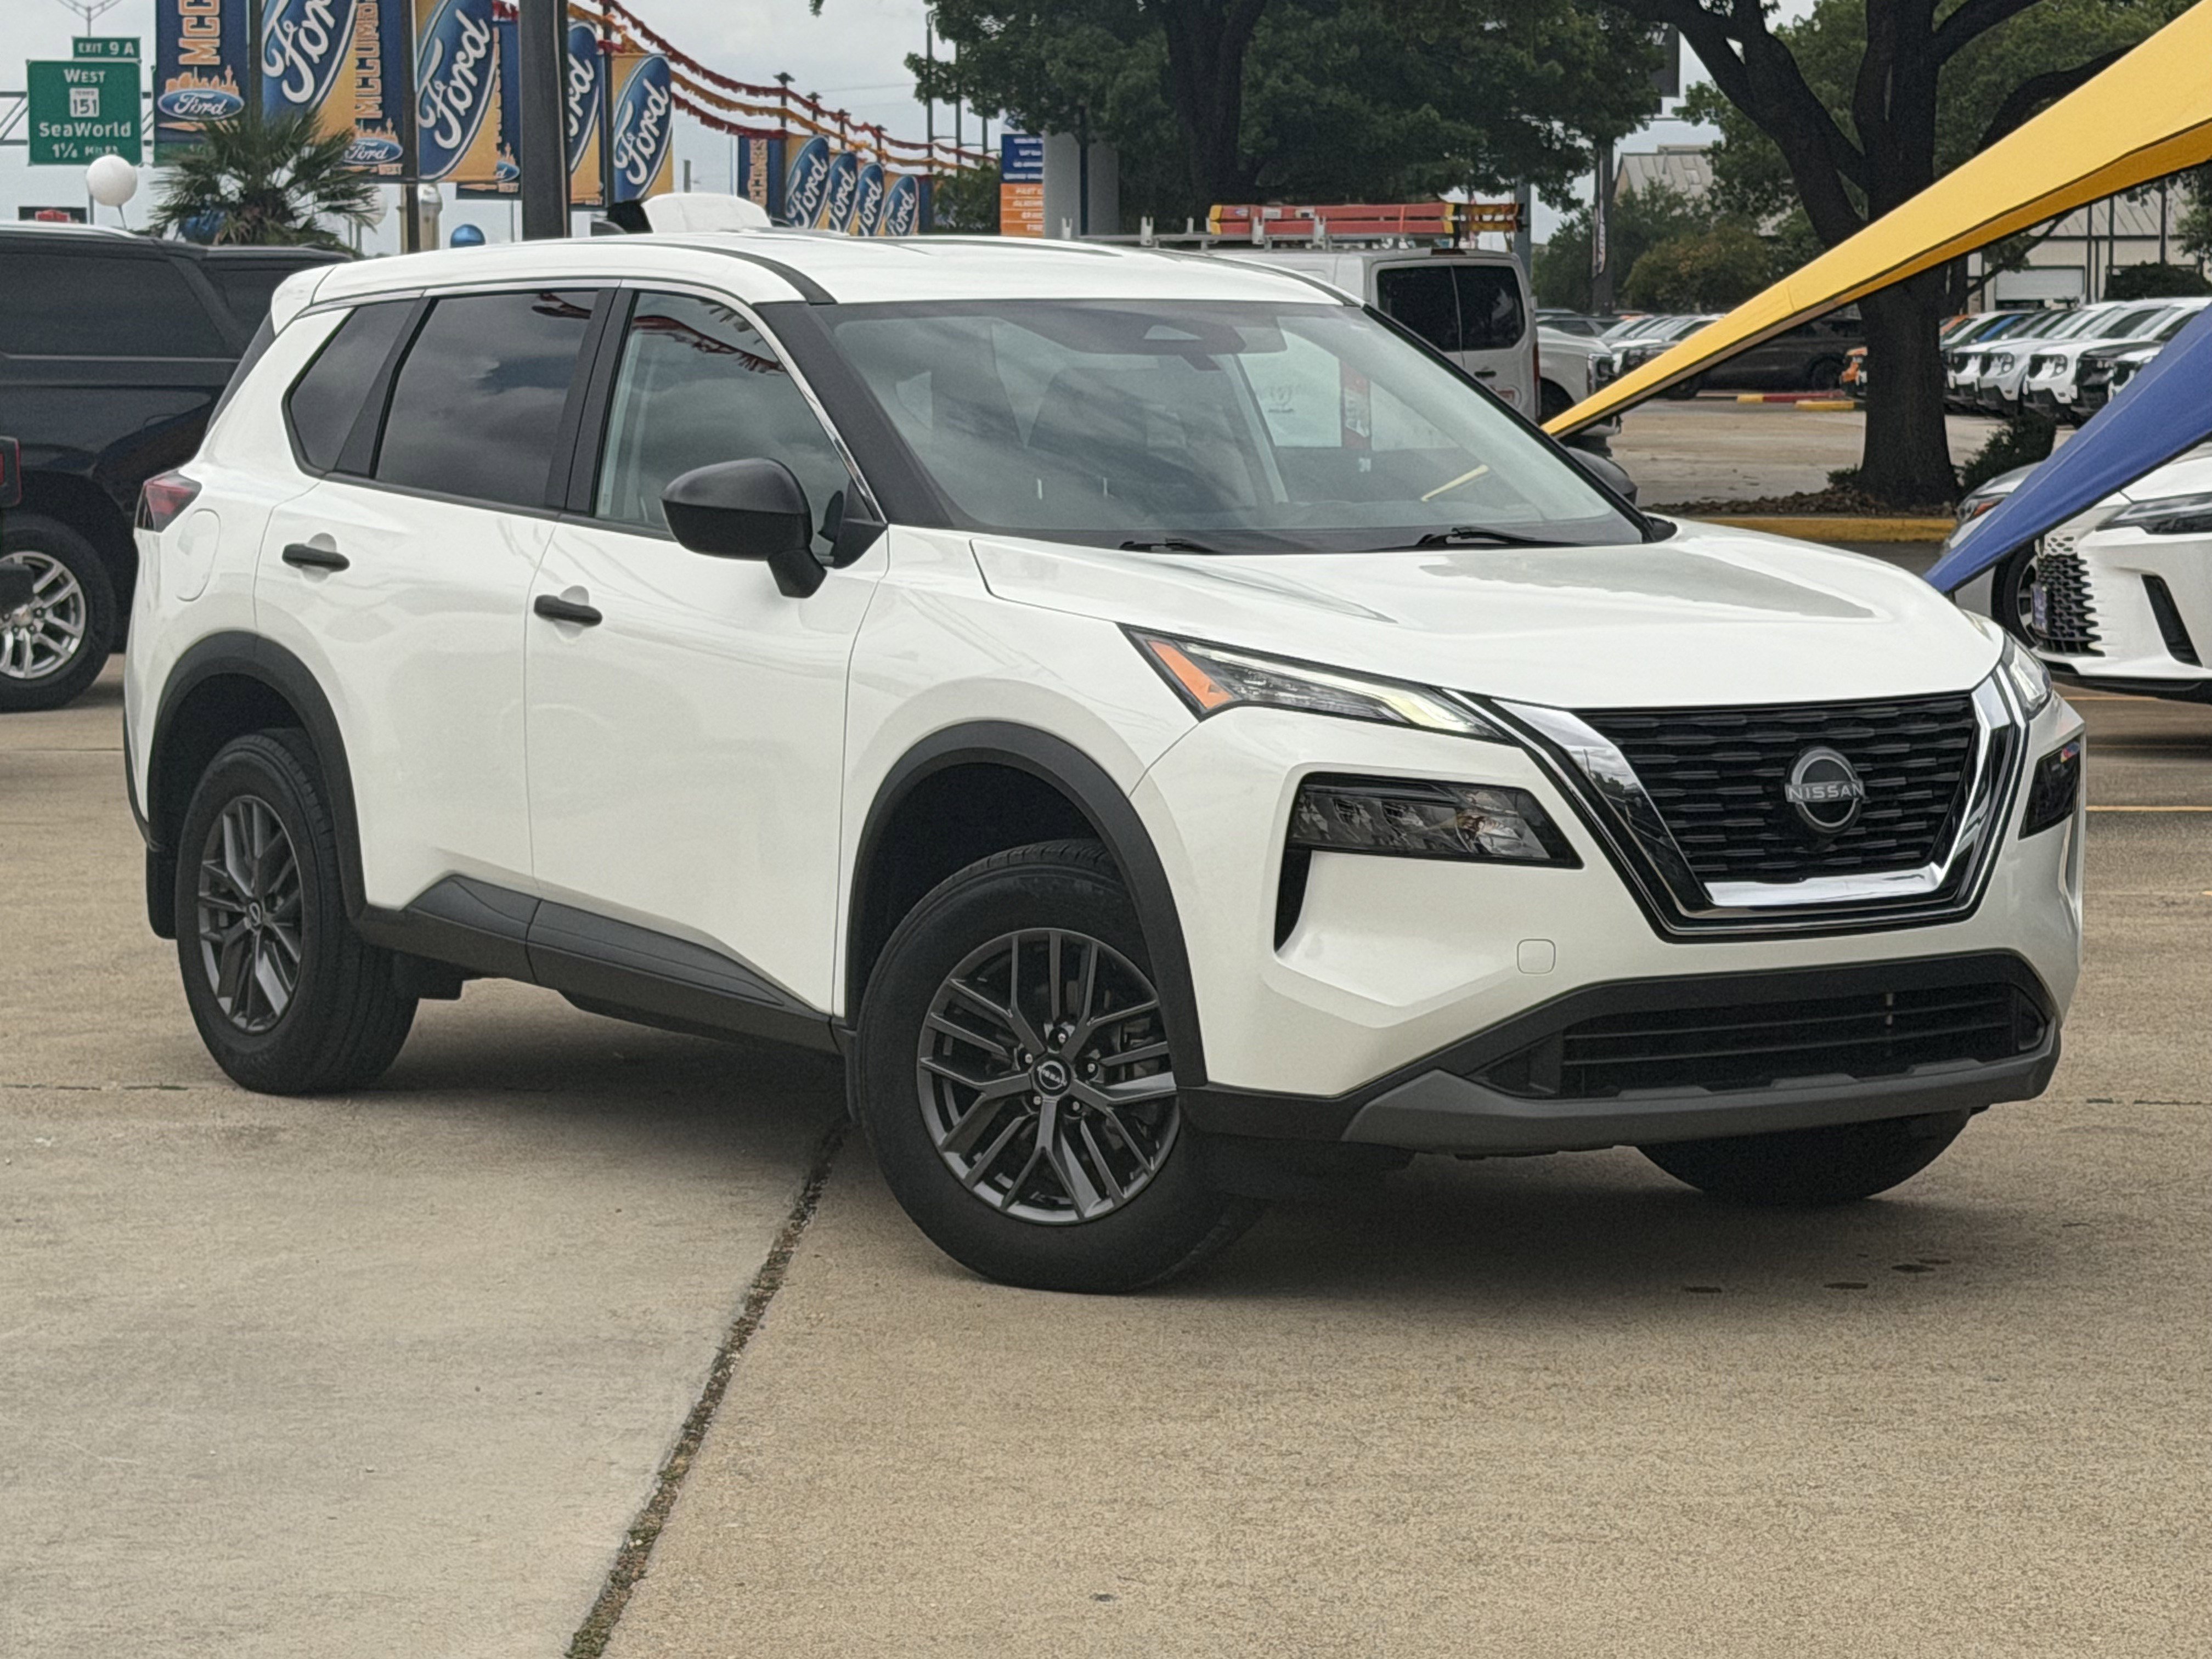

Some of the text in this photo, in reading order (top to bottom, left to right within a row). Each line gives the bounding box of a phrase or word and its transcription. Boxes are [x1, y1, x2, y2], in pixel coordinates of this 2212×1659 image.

[78, 43, 103, 53] EXIT
[262, 0, 335, 103] For
[416, 9, 490, 149] Ford
[73, 99, 97, 114] 151
[173, 92, 228, 115] Ford
[39, 122, 131, 137] SeaWorld
[614, 78, 669, 185] Ford
[345, 142, 390, 160] Ford
[786, 154, 827, 228] Ford
[1789, 784, 1863, 799] NISSAN
